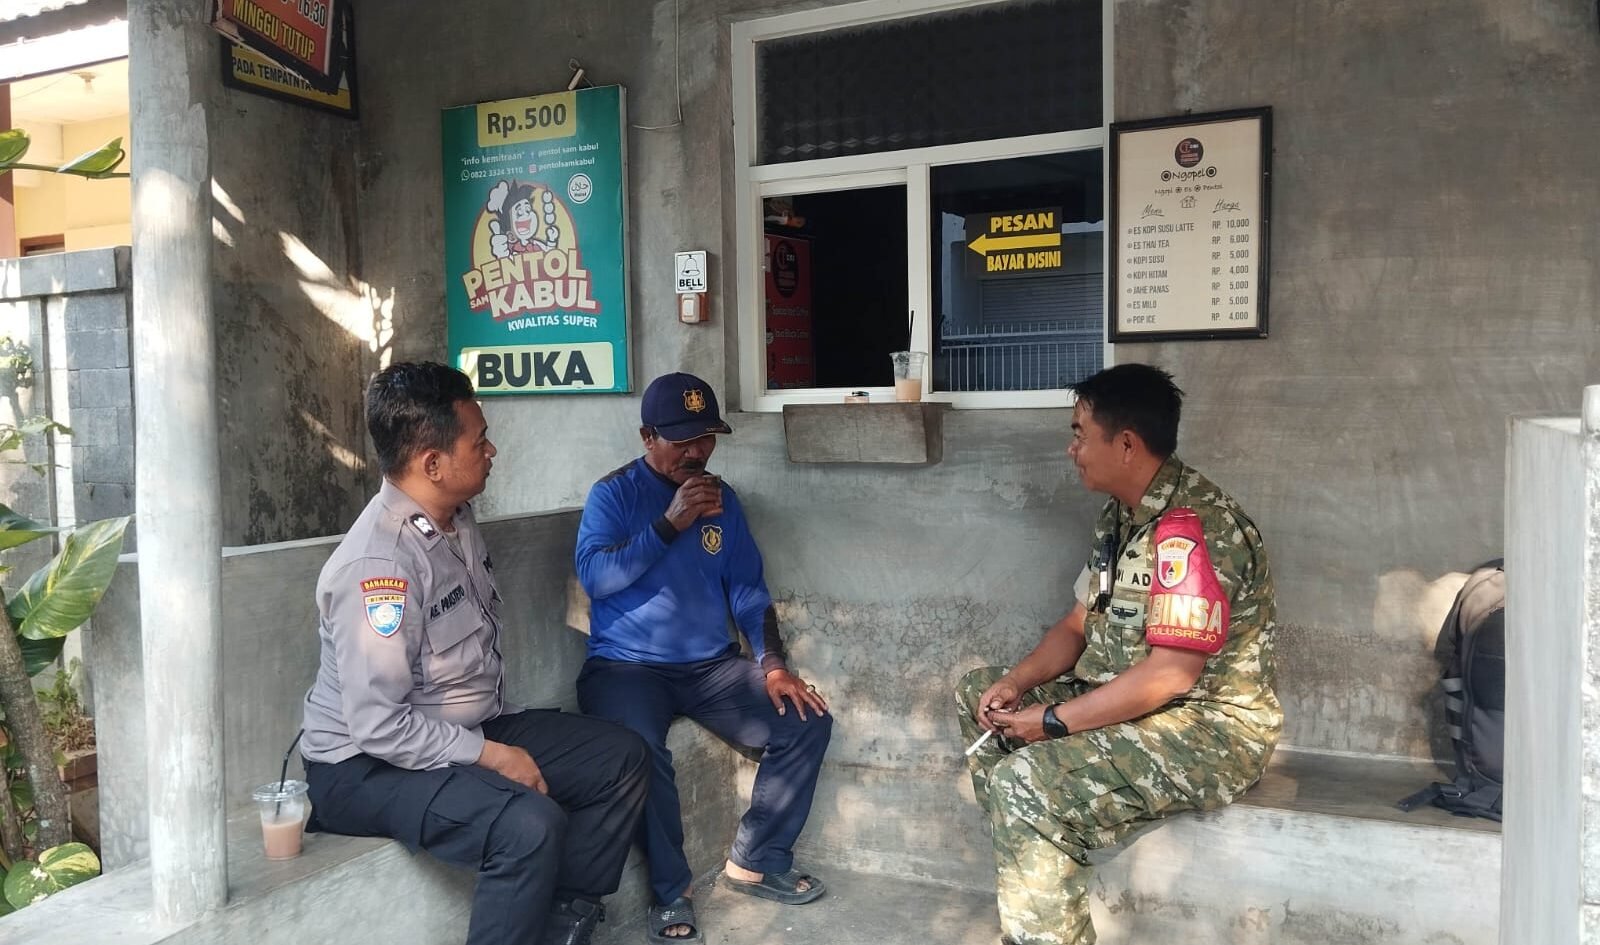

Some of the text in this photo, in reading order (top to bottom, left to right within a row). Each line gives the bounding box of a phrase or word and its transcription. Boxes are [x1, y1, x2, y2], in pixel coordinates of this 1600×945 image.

[233, 0, 315, 60] MINGGU TUTUP
[232, 56, 255, 76] PADA
[487, 104, 566, 137] Rp.500
[538, 142, 598, 158] pentol sam kabul
[990, 212, 1054, 233] PESAN
[1176, 223, 1194, 232] LATTE
[1143, 240, 1156, 249] THAI
[1158, 240, 1169, 248] TEA
[987, 250, 1061, 272] BAYAR DISINI
[1133, 255, 1164, 264] KOPI SUSU
[463, 248, 586, 299] PENTOL
[1133, 270, 1168, 279] KOPI HITAM
[680, 278, 703, 287] BELL
[1133, 285, 1169, 294] JAHE PANAS
[470, 280, 596, 317] SAM KABUL
[1133, 300, 1157, 309] ES MILO
[508, 315, 597, 332] KWALITAS SUPER
[1133, 315, 1156, 324] POP ICE
[477, 350, 594, 387] BUKA
[1131, 573, 1151, 587] AD
[1150, 627, 1216, 643] TULUSREJO
